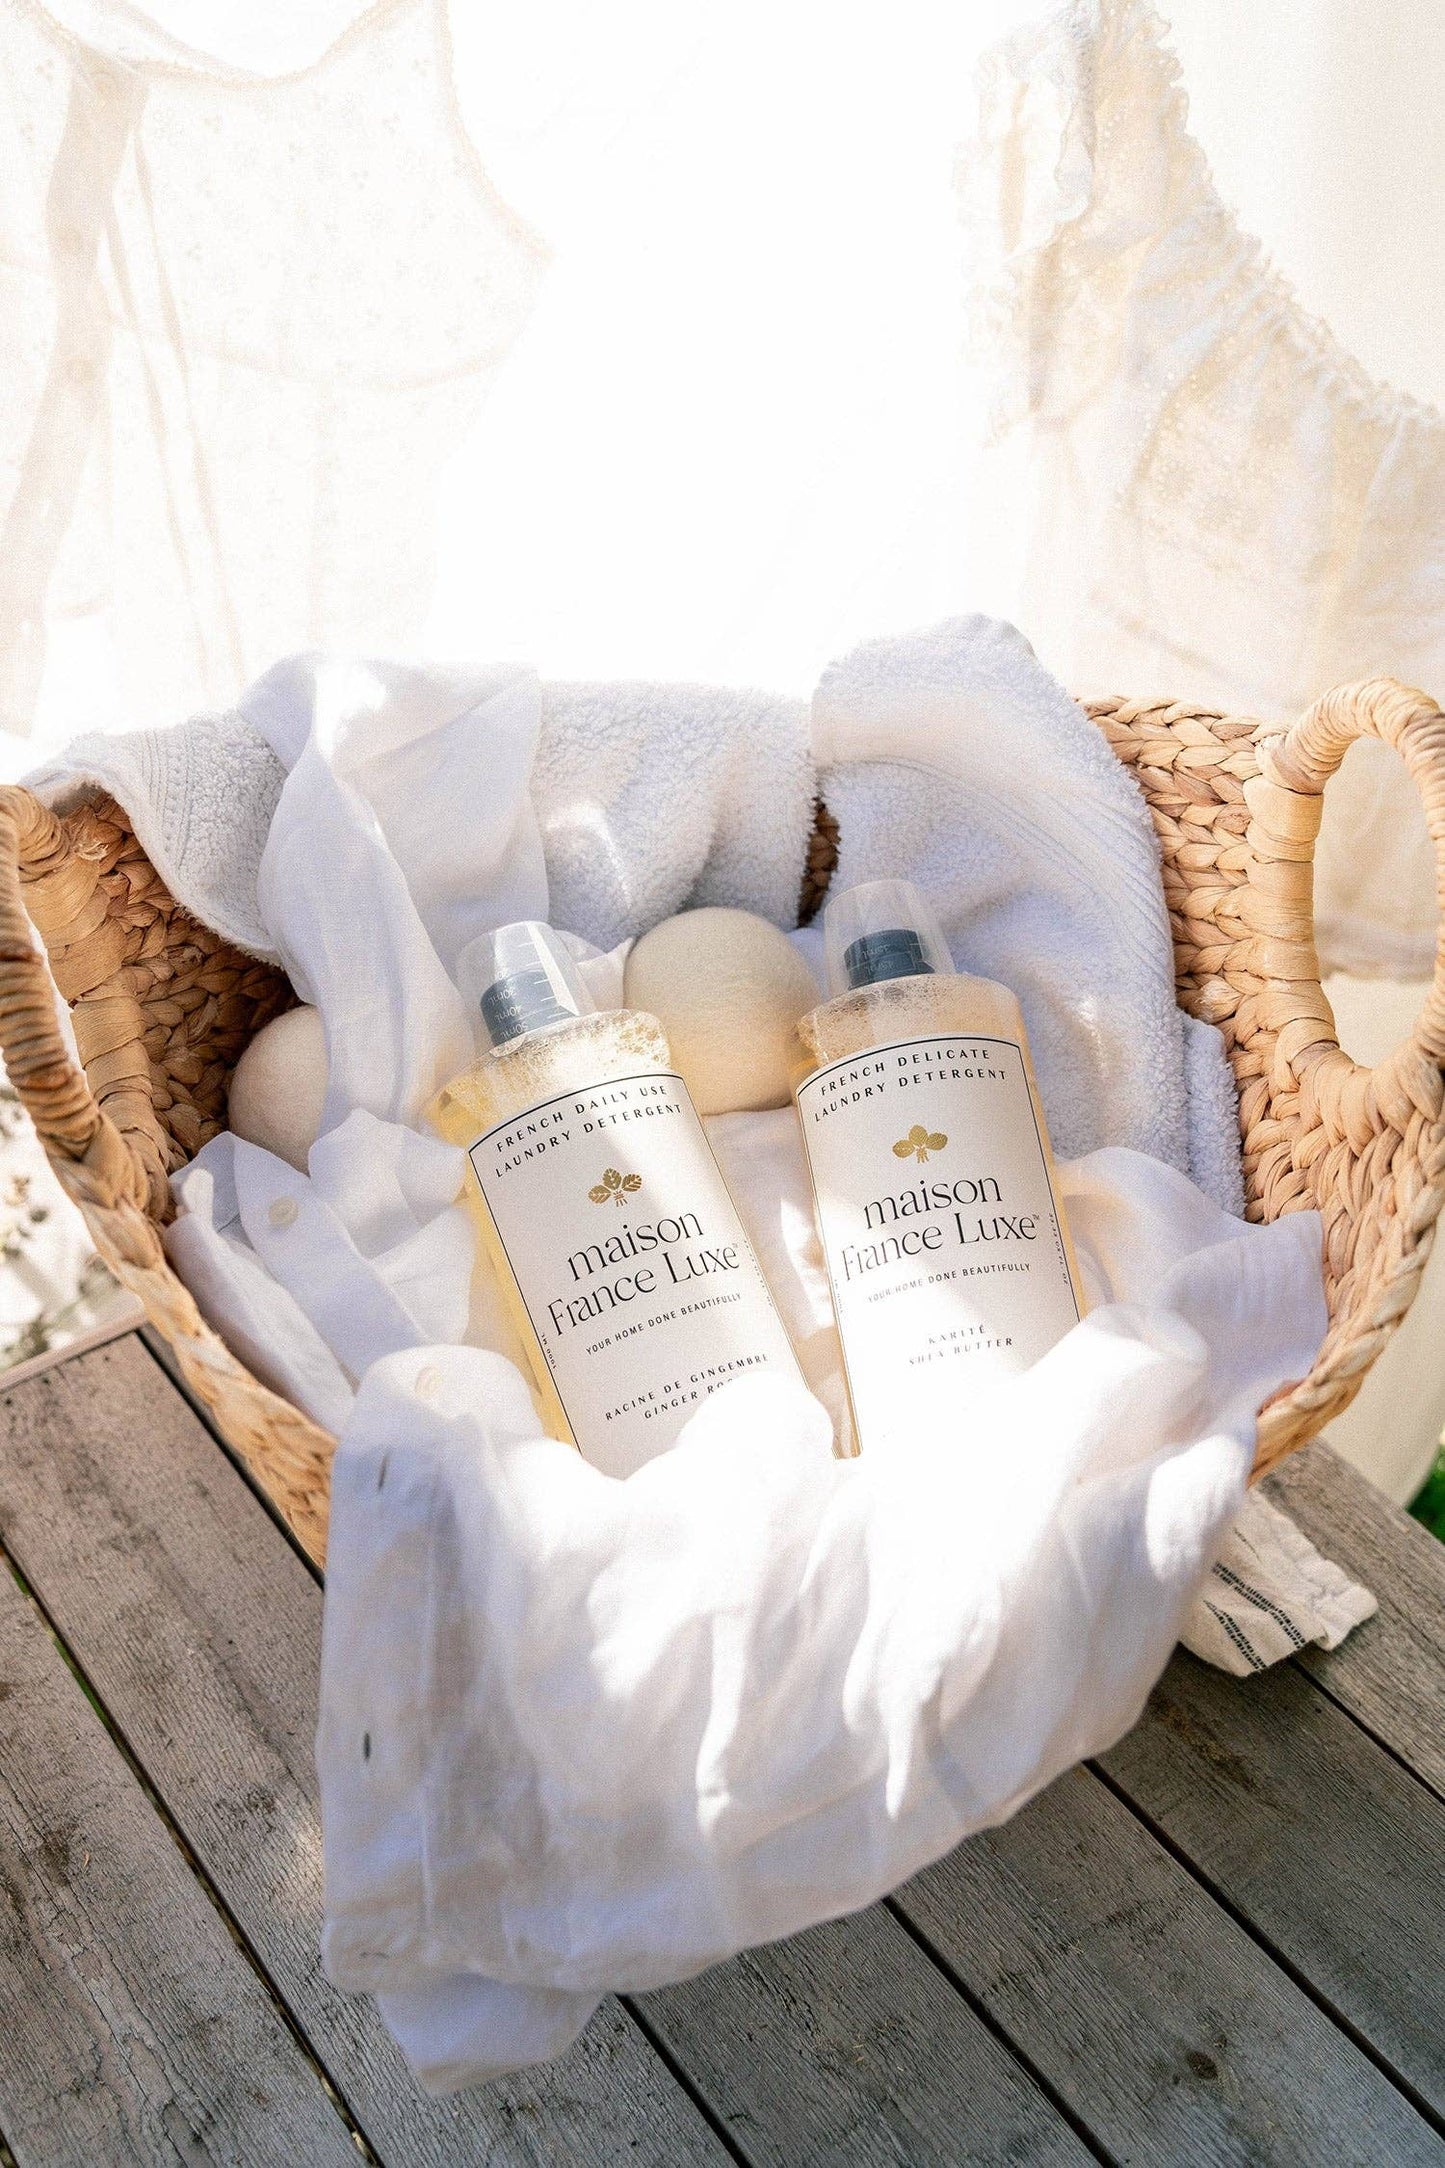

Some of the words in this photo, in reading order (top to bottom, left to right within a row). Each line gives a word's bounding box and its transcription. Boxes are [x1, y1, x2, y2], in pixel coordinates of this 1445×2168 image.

[813, 1082, 886, 1122] LAUNDRY
[898, 1068, 1007, 1087] DETERGENT
[821, 1061, 886, 1096] FRENCH
[897, 1048, 991, 1067] DELICATE
[495, 1130, 571, 1178] LAUNDRY
[583, 1104, 682, 1133] DETERGENT
[496, 1111, 564, 1153] FRENCH
[574, 1090, 629, 1114] DAILY
[639, 1085, 668, 1097] USE
[863, 1177, 1003, 1229] maison
[567, 1213, 704, 1281] maison
[841, 1225, 944, 1281] France
[547, 1269, 657, 1336] France
[895, 1279, 924, 1294] HOME
[928, 1270, 958, 1284] DONE
[962, 1263, 1032, 1277] BEAUTIFULLY
[585, 1338, 612, 1355] YOUR
[614, 1323, 644, 1341] HOME
[648, 1310, 677, 1327] DONE
[680, 1292, 742, 1316] BEAUTIFULLY
[605, 1391, 656, 1421] RACINE
[663, 1380, 682, 1394] DE
[690, 1353, 769, 1384] GINGEMBRE
[644, 1391, 699, 1419] GINGER
